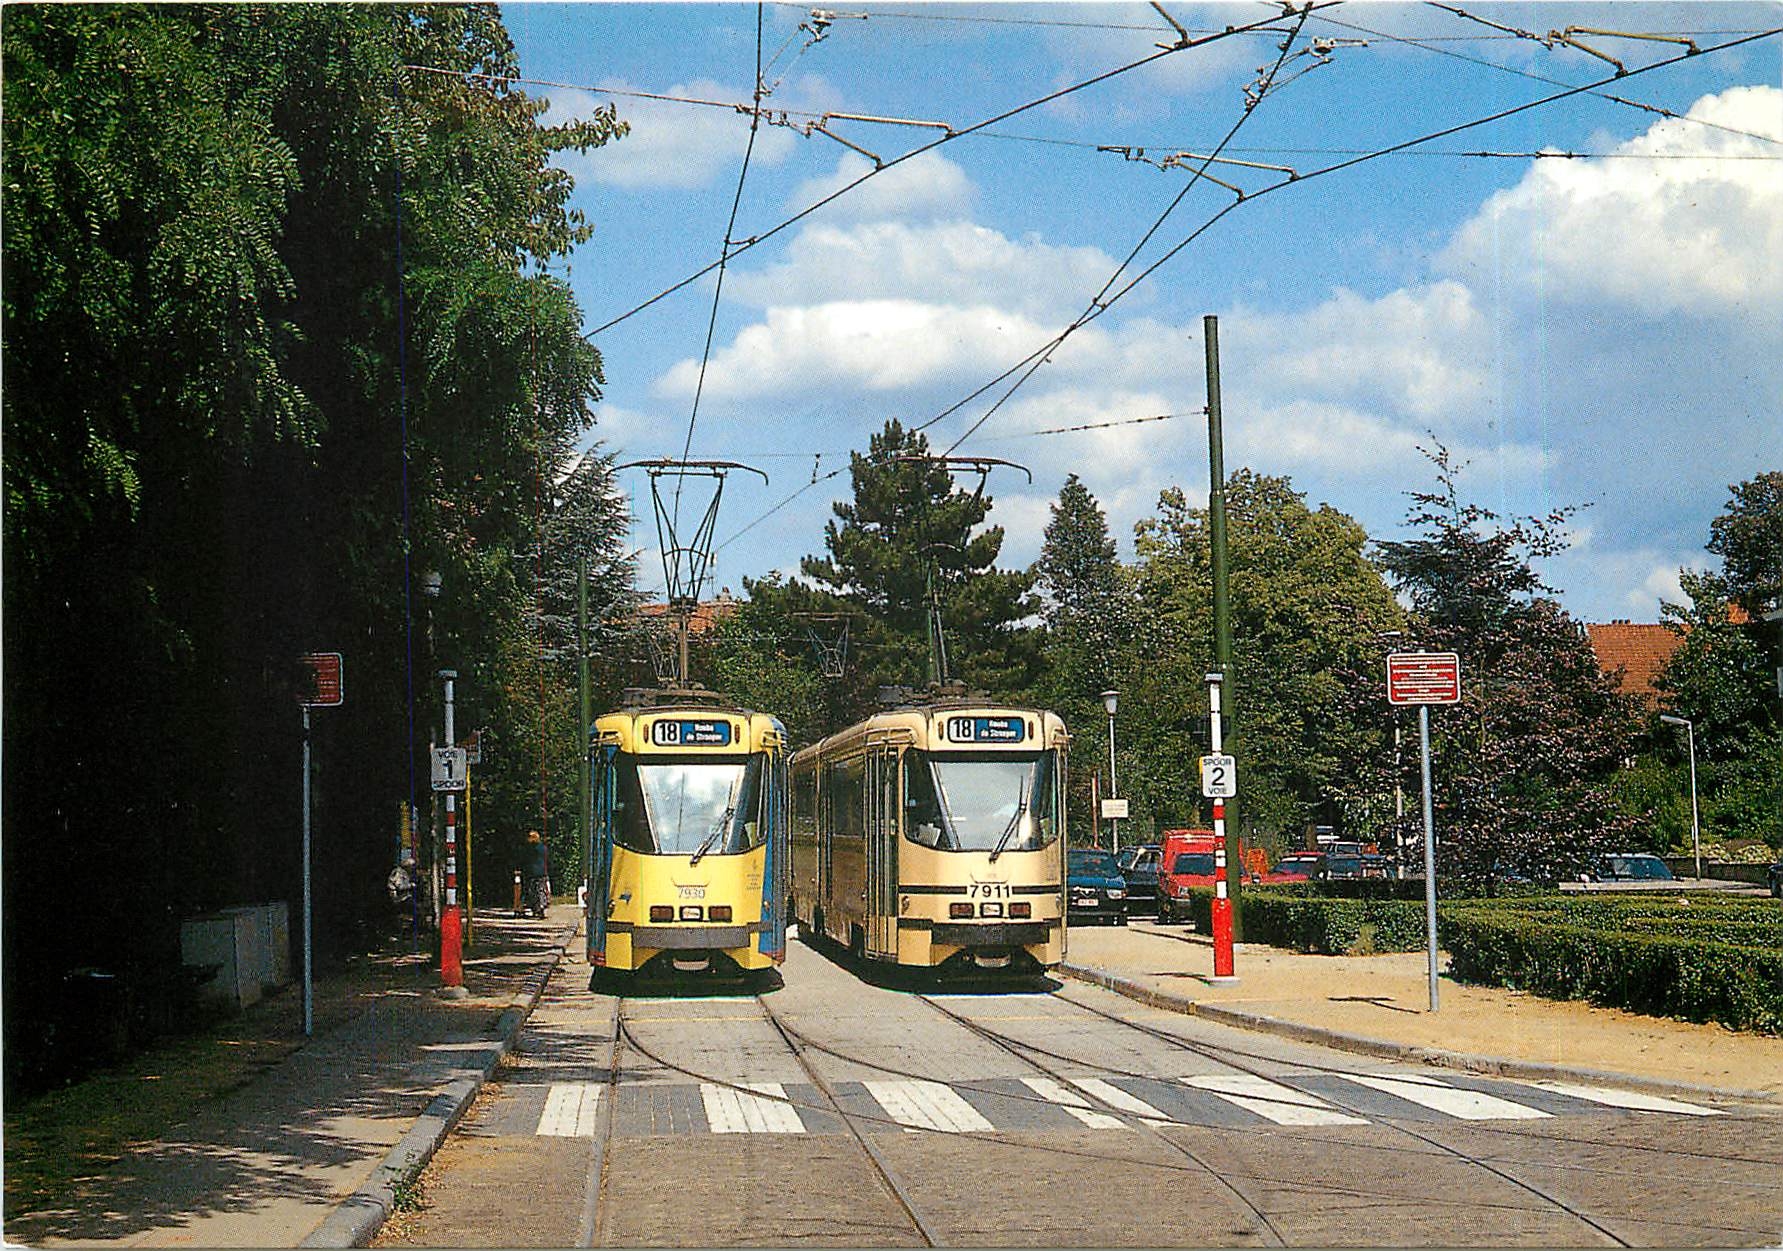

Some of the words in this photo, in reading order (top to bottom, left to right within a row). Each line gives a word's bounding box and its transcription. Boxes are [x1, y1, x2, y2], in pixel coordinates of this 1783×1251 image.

[659, 723, 677, 741] 18
[953, 719, 971, 738] 18
[443, 760, 453, 779] 1
[1203, 758, 1232, 766] SPOOR
[1211, 767, 1225, 786] 2
[1209, 787, 1227, 795] VOIE
[969, 885, 1010, 898] 7911
